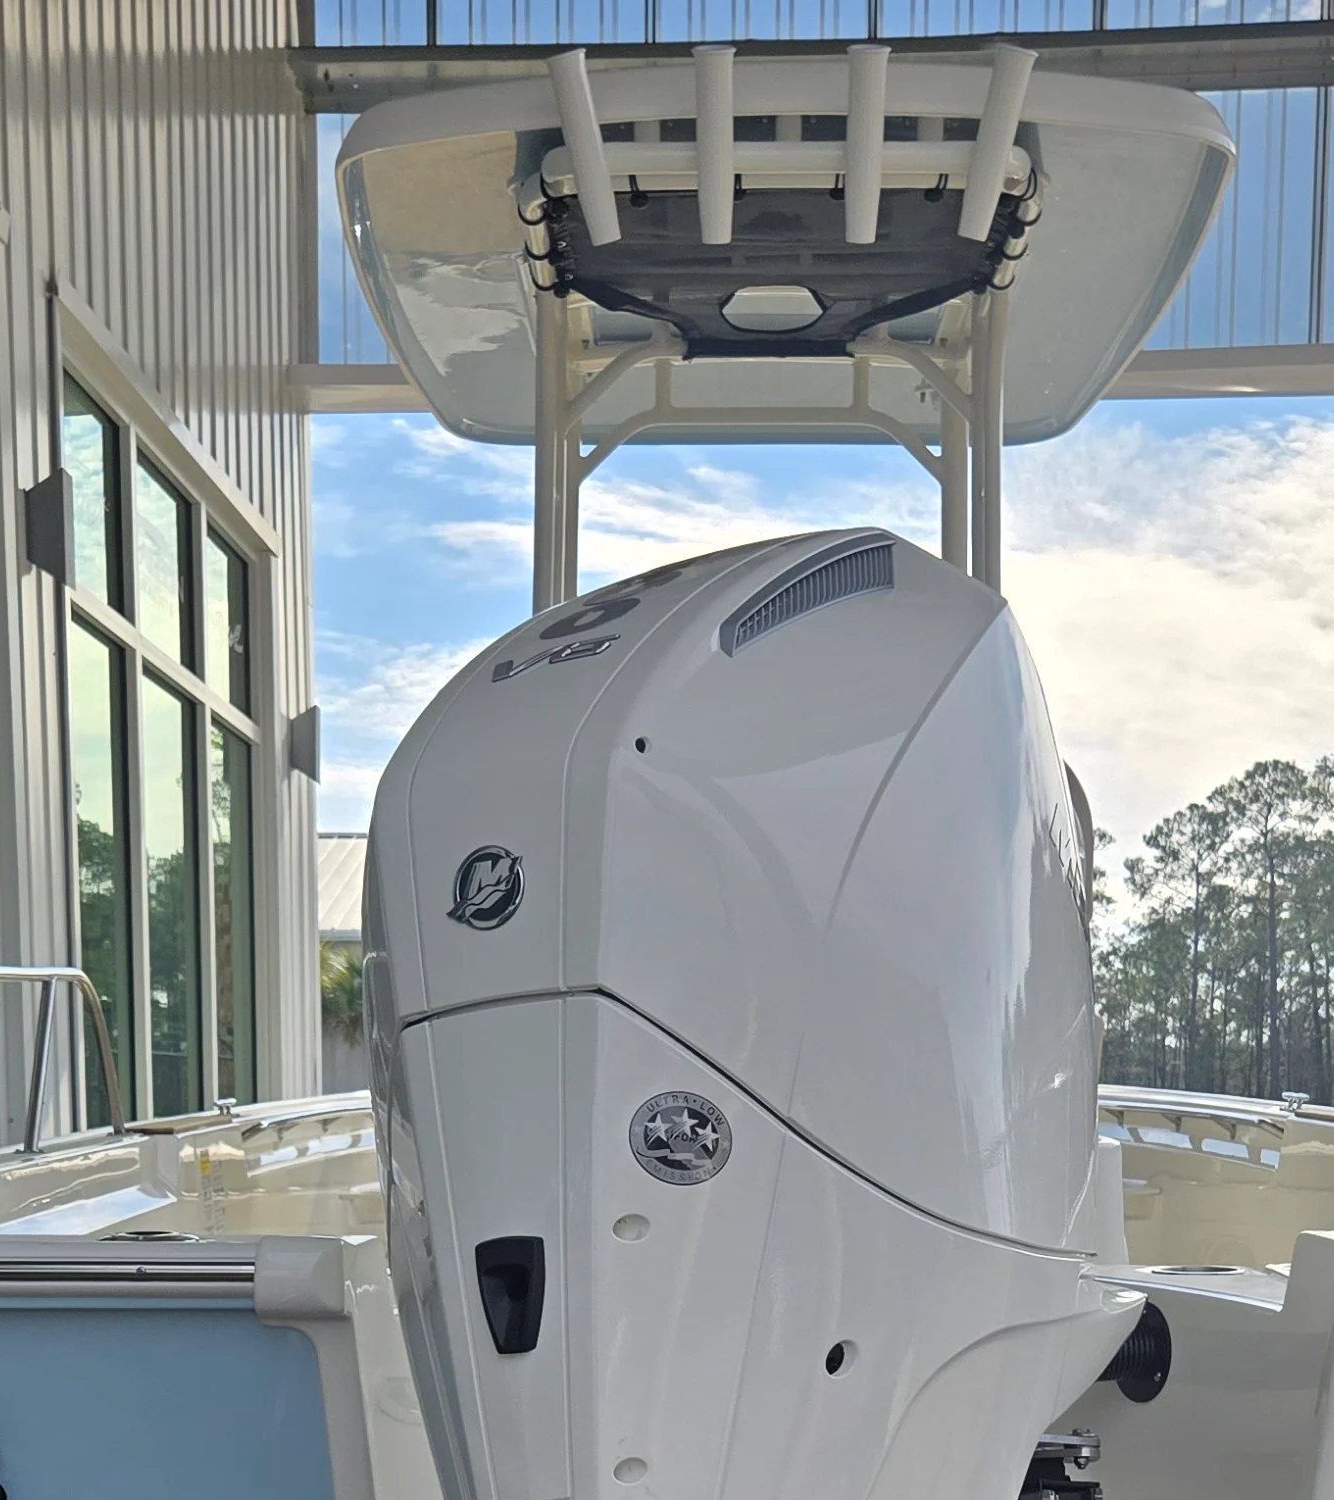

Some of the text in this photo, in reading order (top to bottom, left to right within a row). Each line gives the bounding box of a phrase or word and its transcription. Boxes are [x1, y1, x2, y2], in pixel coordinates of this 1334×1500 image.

[647, 1094, 725, 1126] ULTRA LOW
[645, 1159, 712, 1181] EMISSION
